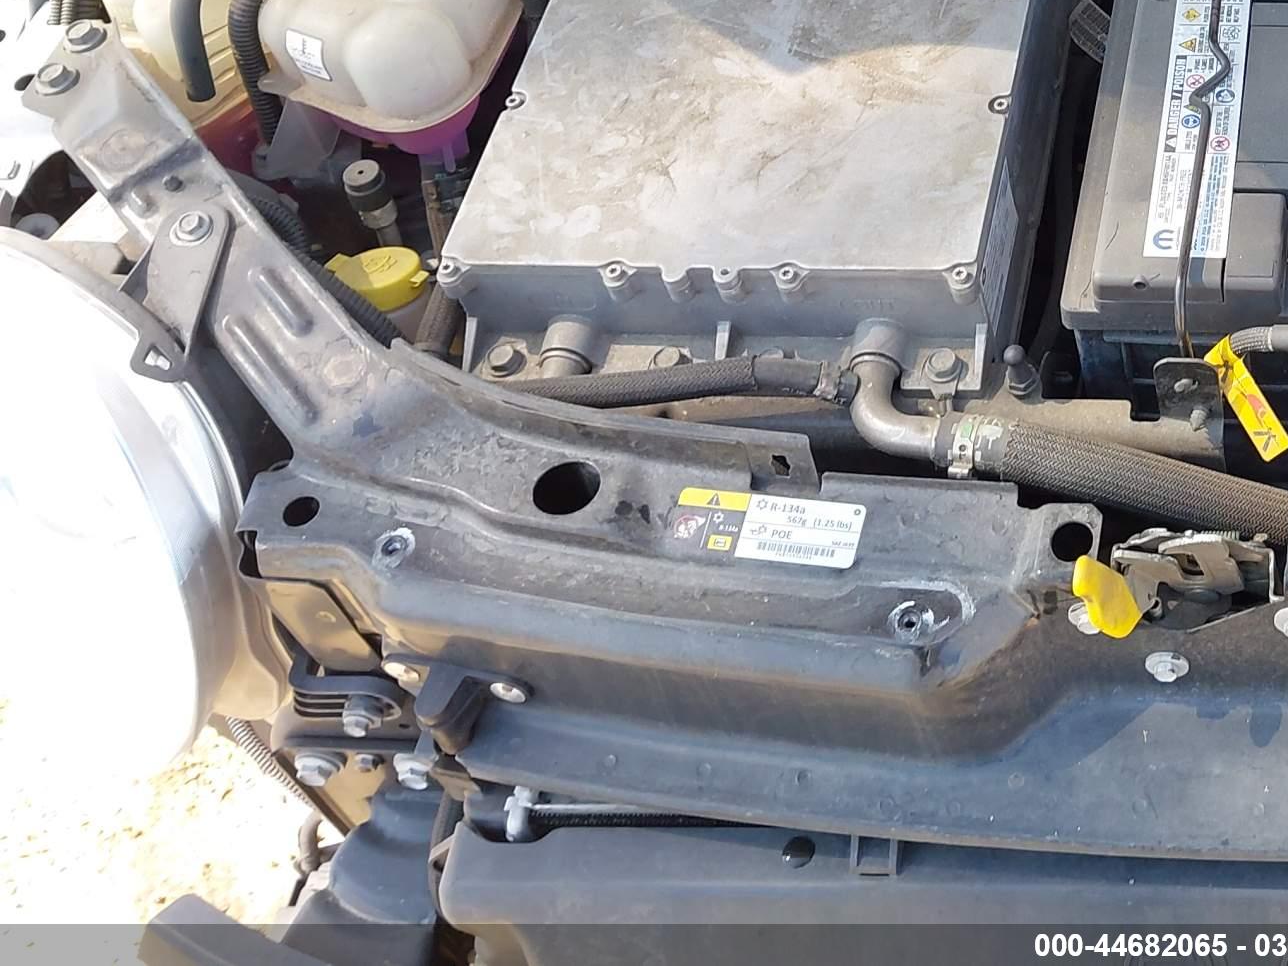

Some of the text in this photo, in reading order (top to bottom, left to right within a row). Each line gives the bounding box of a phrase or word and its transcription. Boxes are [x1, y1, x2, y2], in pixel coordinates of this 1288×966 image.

[1172, 58, 1187, 90] POISON
[1167, 99, 1182, 136] DANGER
[770, 501, 806, 514] R-134a
[771, 529, 793, 540] POE
